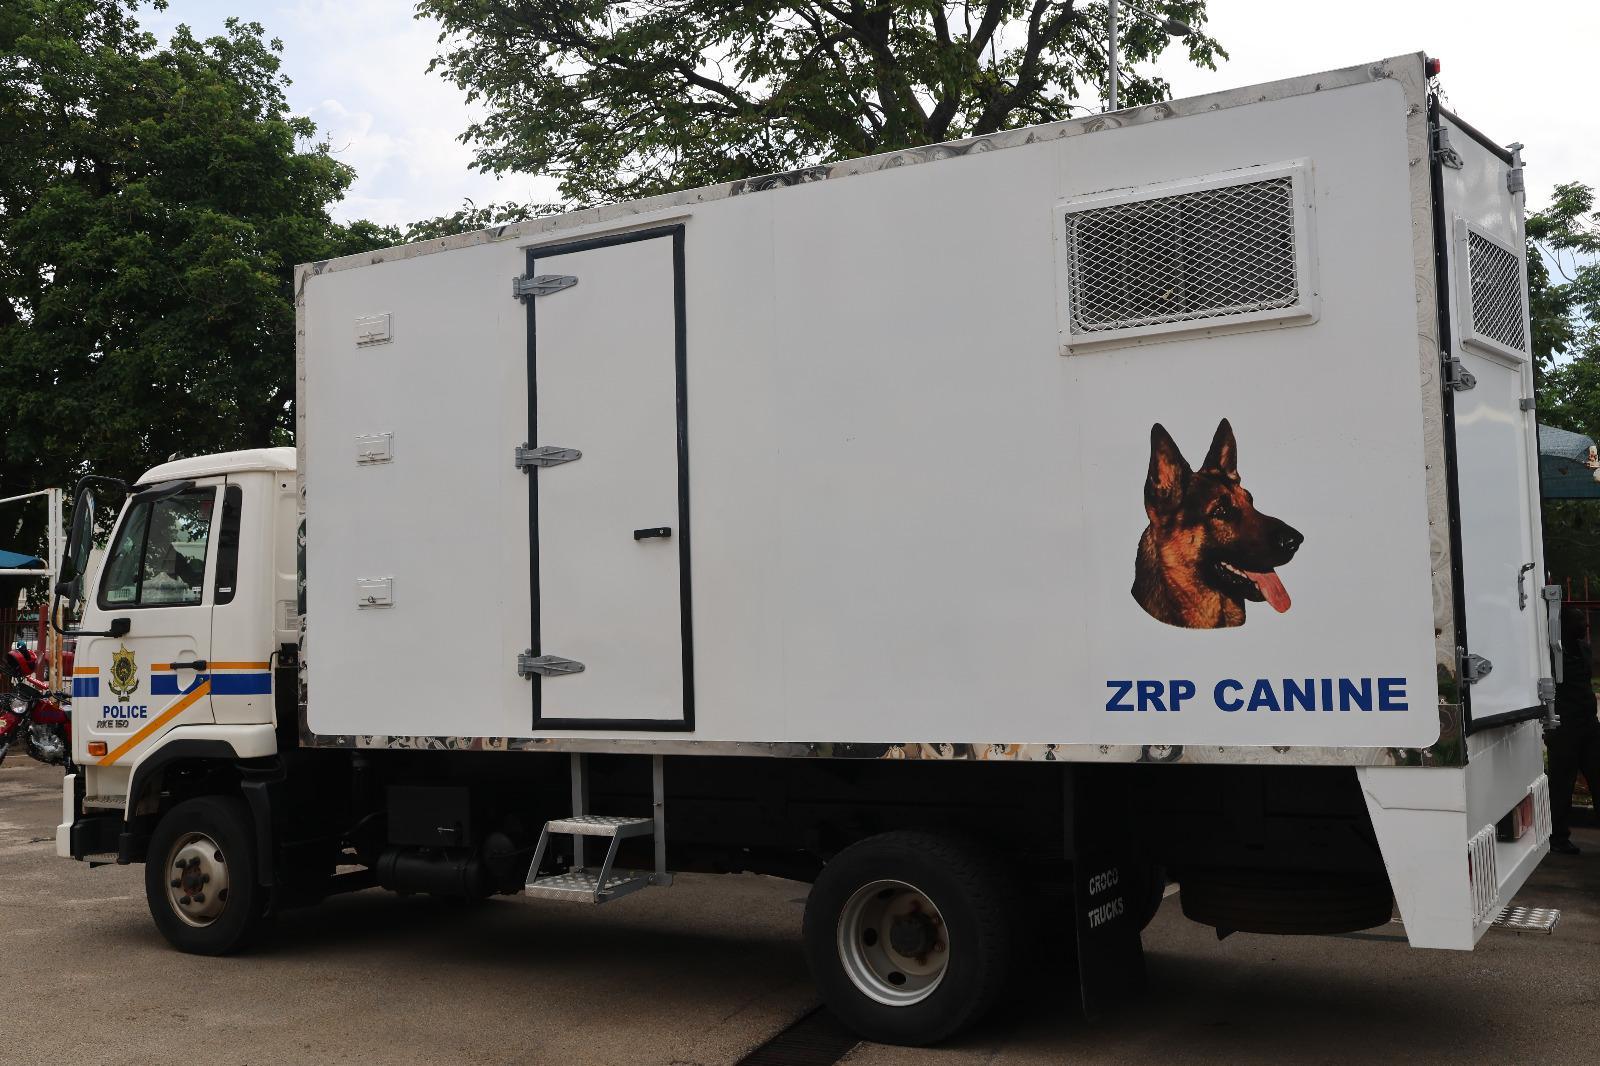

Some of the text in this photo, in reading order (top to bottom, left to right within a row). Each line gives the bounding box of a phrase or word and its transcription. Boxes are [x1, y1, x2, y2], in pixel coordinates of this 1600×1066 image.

[1106, 678, 1409, 712] ZRP CANINE
[103, 705, 148, 718] POLICE
[1089, 867, 1119, 895] CROCO
[1088, 897, 1124, 928] TRUCKS
